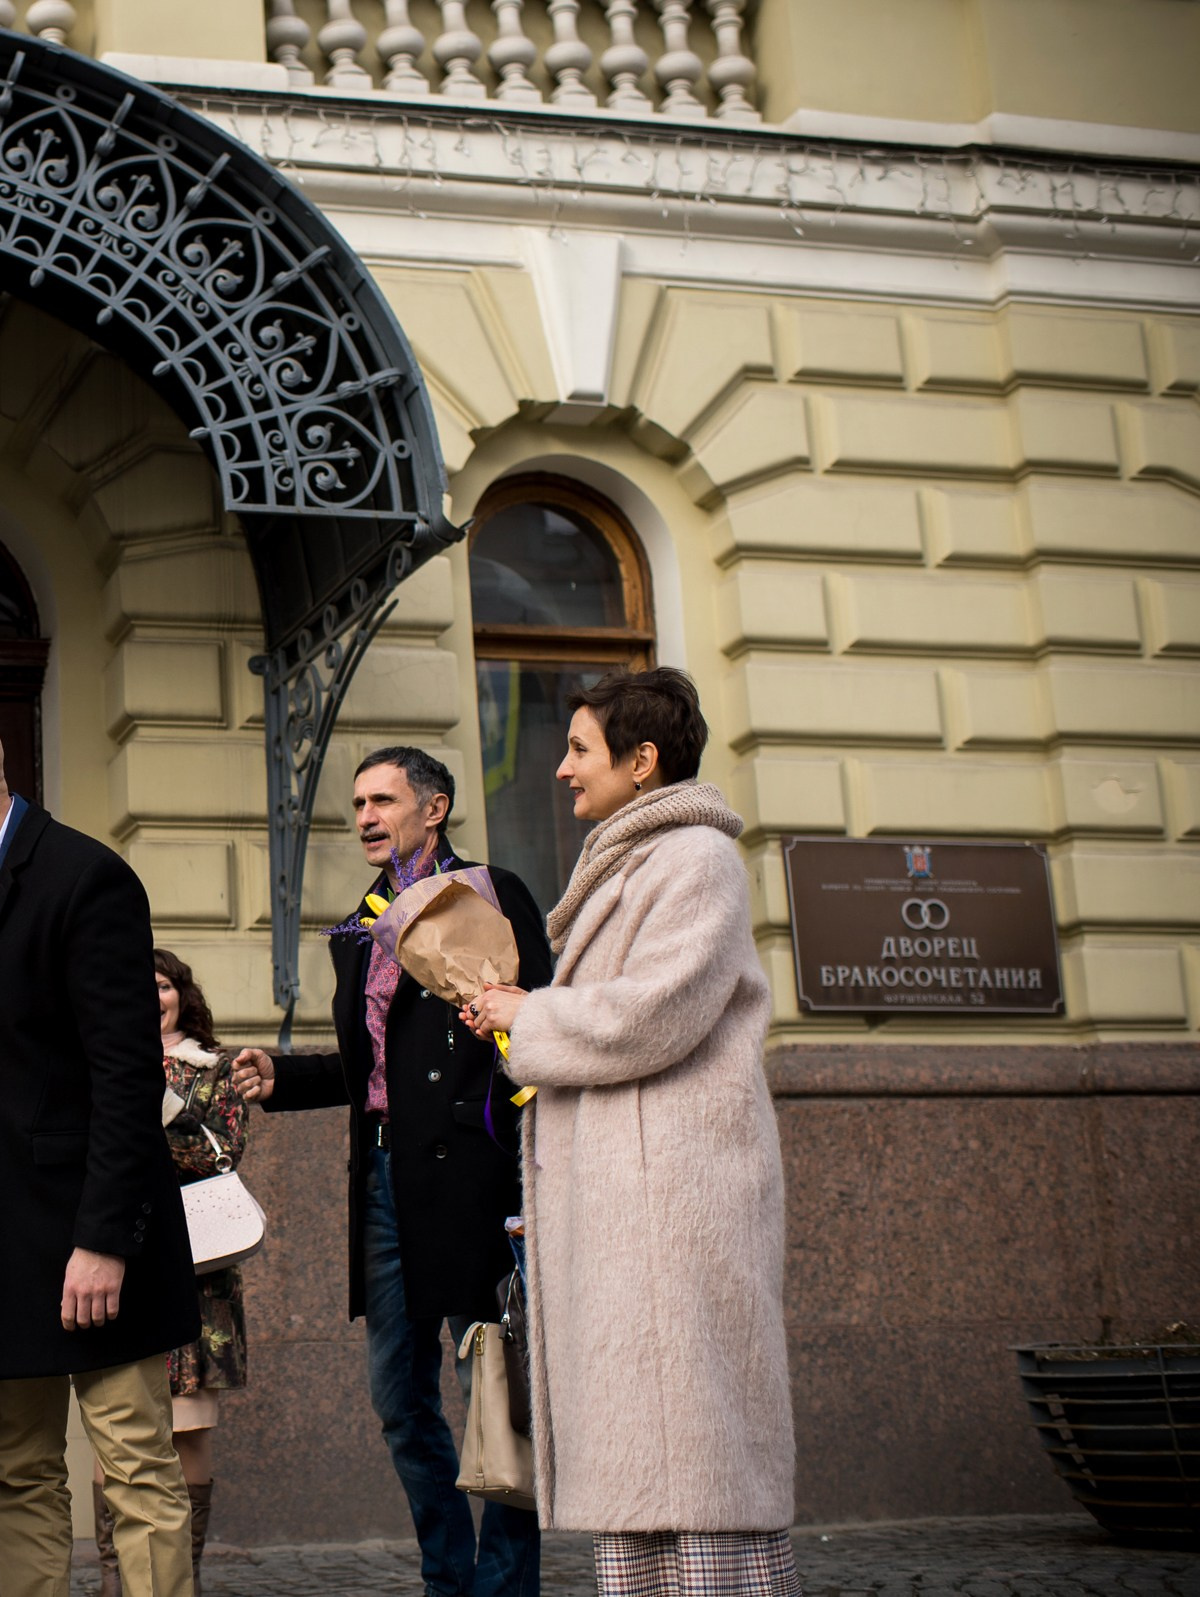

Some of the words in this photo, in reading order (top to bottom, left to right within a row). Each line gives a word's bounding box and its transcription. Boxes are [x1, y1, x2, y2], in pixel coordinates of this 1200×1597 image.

[881, 936, 980, 960] ДВОРЕЦ
[820, 965, 1043, 989] БРАКОСОЧЕТАНИЯ
[969, 992, 986, 1005] 52
